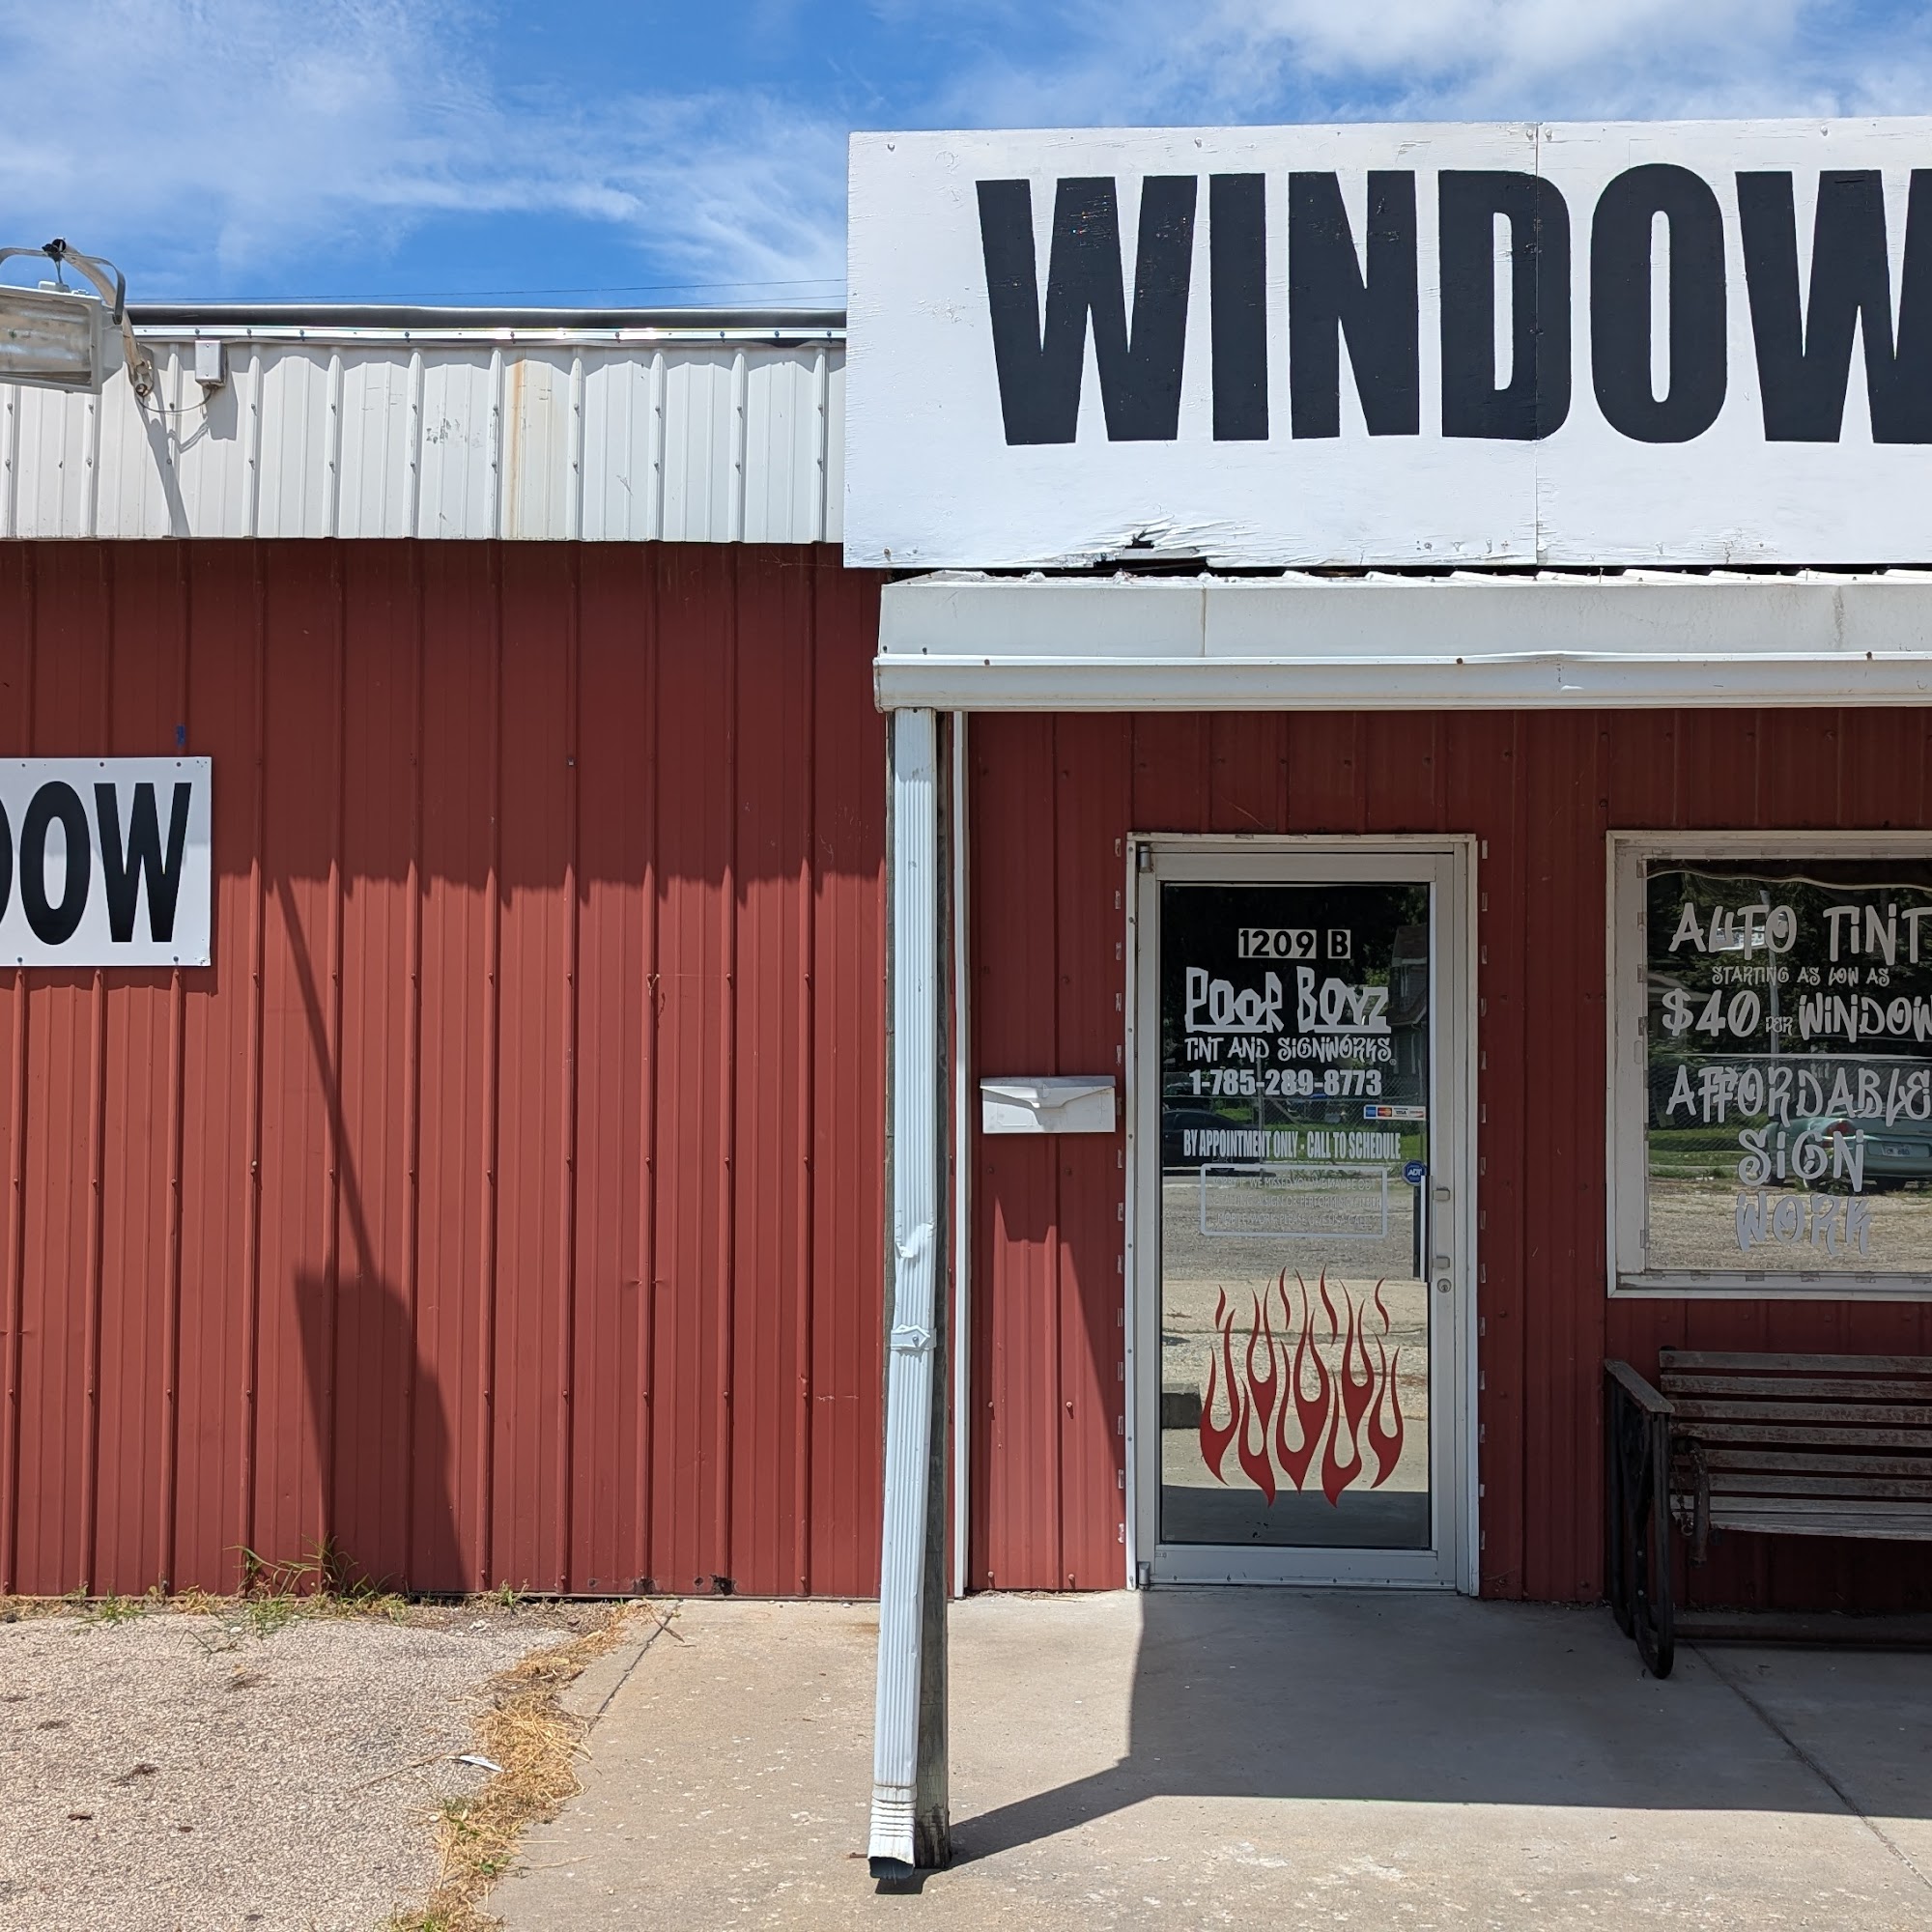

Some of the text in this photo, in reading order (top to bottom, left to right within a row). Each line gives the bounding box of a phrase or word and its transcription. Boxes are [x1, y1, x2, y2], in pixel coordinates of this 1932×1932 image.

[976, 162, 1932, 445] WINDOW
[0, 781, 192, 946] OW
[1239, 929, 1349, 957] 1209 B
[1668, 902, 1932, 965] AUTO TINT
[1712, 966, 1890, 987] STARTING AS LOW AS
[1184, 966, 1392, 1034] POOR BOYZ
[1662, 988, 1932, 1043] $40 PER WINDOW
[1184, 1034, 1392, 1064] TINT AND SIGNWORKS
[1189, 1068, 1382, 1095] 1-785-289-8773
[1665, 1065, 1931, 1127] AFFORDABLE
[1183, 1128, 1198, 1157] BY
[1199, 1129, 1272, 1158] APPOINTMENT
[1273, 1130, 1299, 1158] ONLY
[1307, 1131, 1331, 1159] CALL
[1333, 1131, 1347, 1159] TO
[1349, 1131, 1401, 1159] SCHEDULE
[1738, 1128, 1864, 1194] SIGN
[1249, 1177, 1263, 1188] WE
[1264, 1177, 1292, 1189] MISSED
[1347, 1178, 1357, 1190] BE
[1407, 1168, 1422, 1177] ADT
[1264, 1195, 1283, 1207] SIGN
[1287, 1195, 1298, 1207] OR
[1734, 1191, 1872, 1256] WORK
